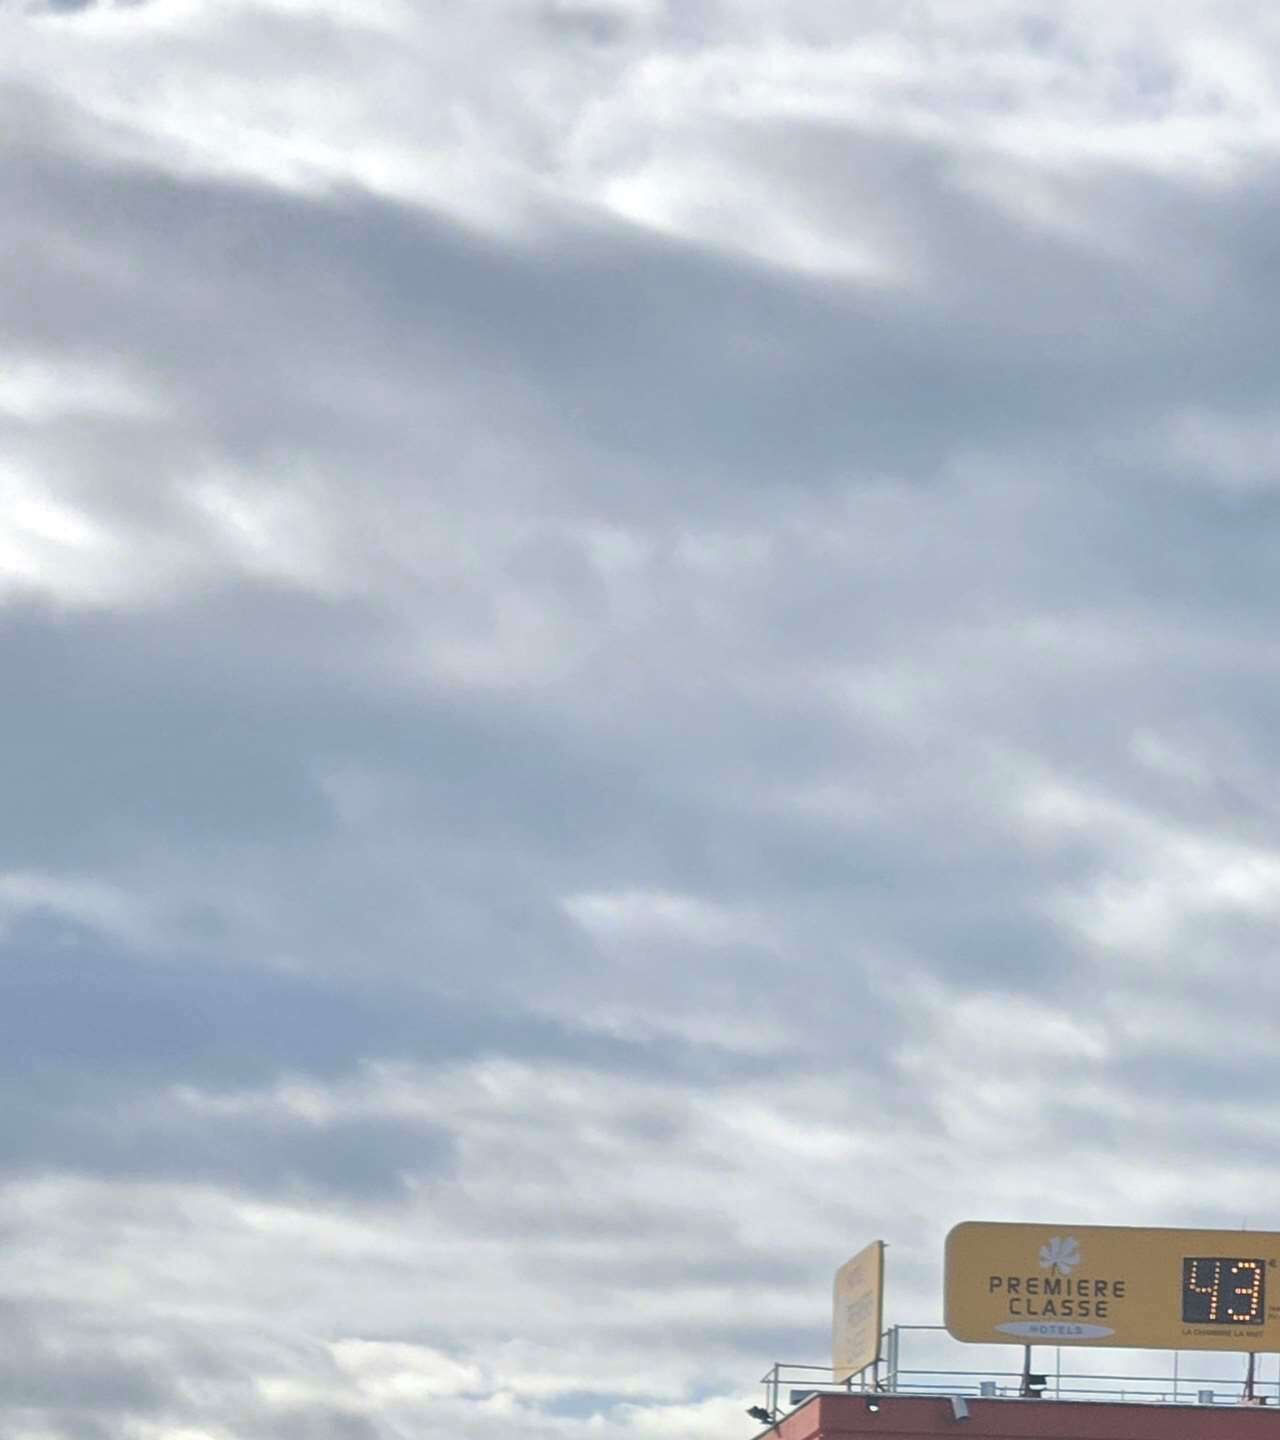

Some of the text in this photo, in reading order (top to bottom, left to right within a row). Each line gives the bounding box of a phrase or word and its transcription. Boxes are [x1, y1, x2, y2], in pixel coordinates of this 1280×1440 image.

[989, 1276, 1126, 1298] PREMIERE
[1189, 1260, 1261, 1320] 43
[1009, 1298, 1108, 1318] CLASSE
[1029, 1325, 1083, 1335] HOTELS
